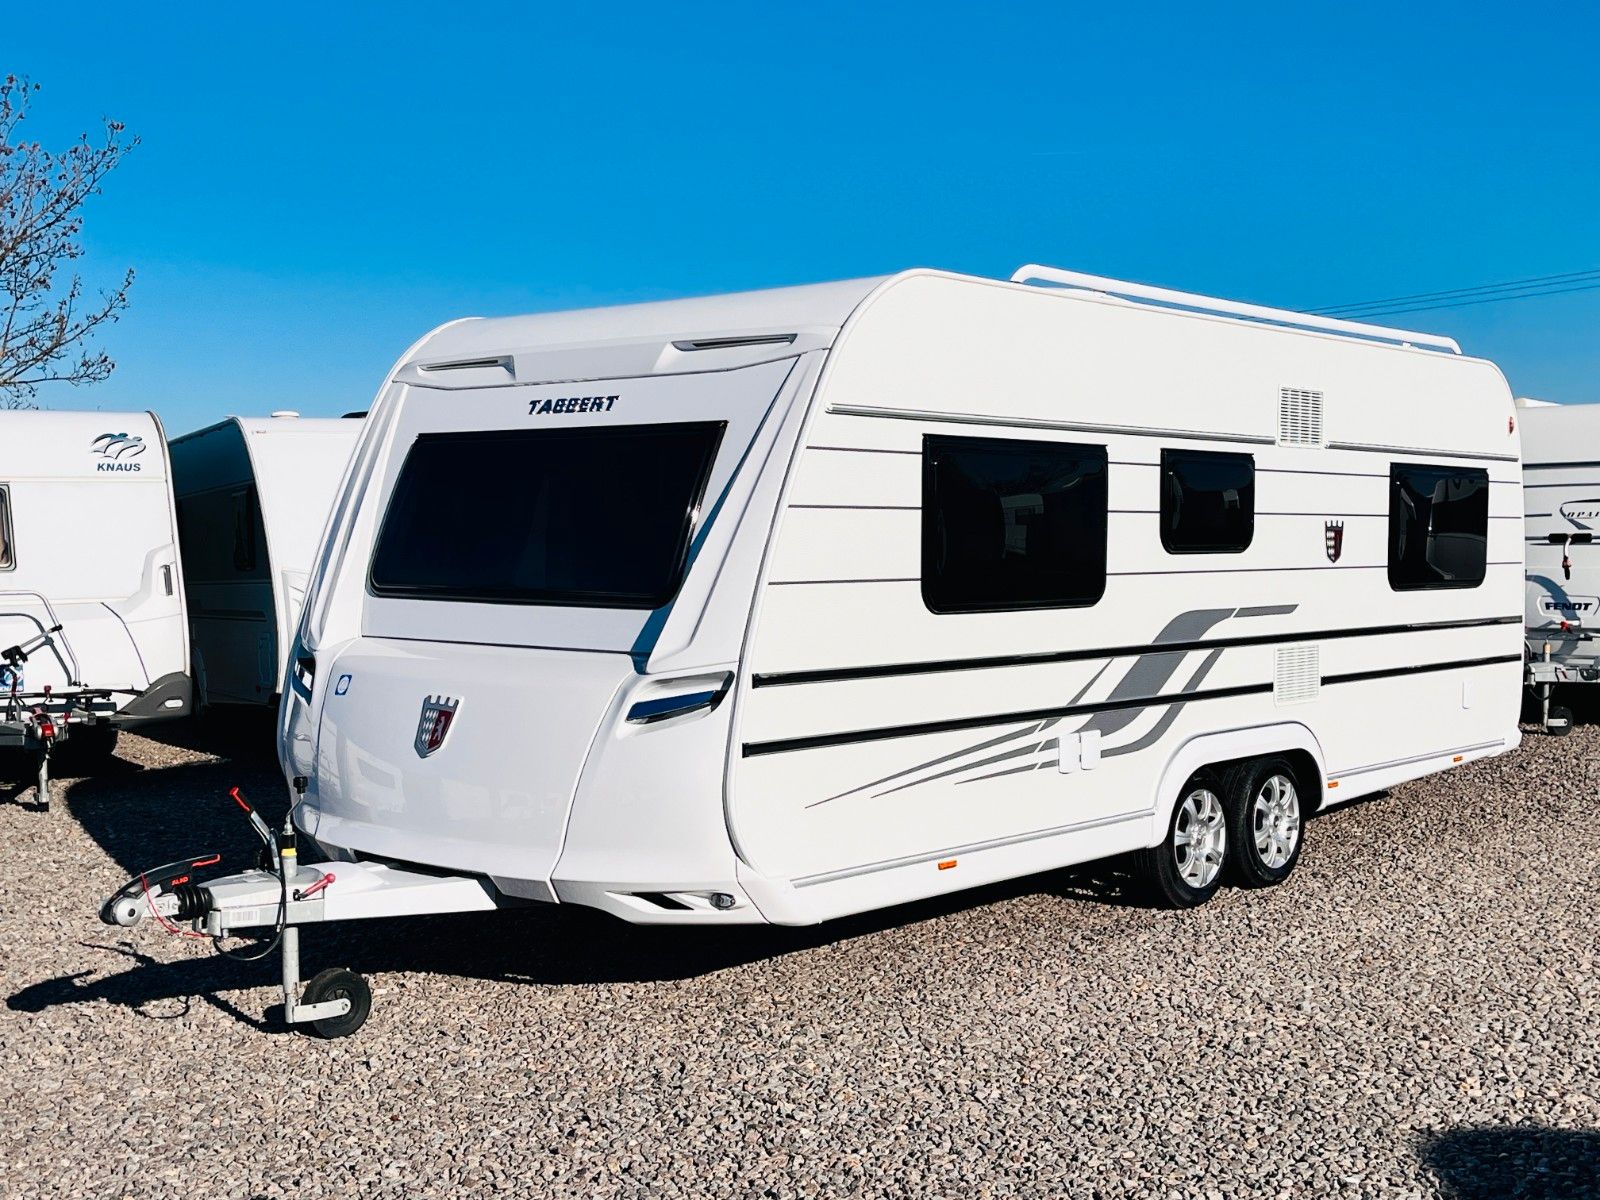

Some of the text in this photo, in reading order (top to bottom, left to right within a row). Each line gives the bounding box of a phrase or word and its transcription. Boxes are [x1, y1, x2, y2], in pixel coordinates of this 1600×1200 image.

[529, 395, 620, 415] TABBERT
[96, 462, 142, 472] KNAUS
[1544, 602, 1593, 611] FENDT
